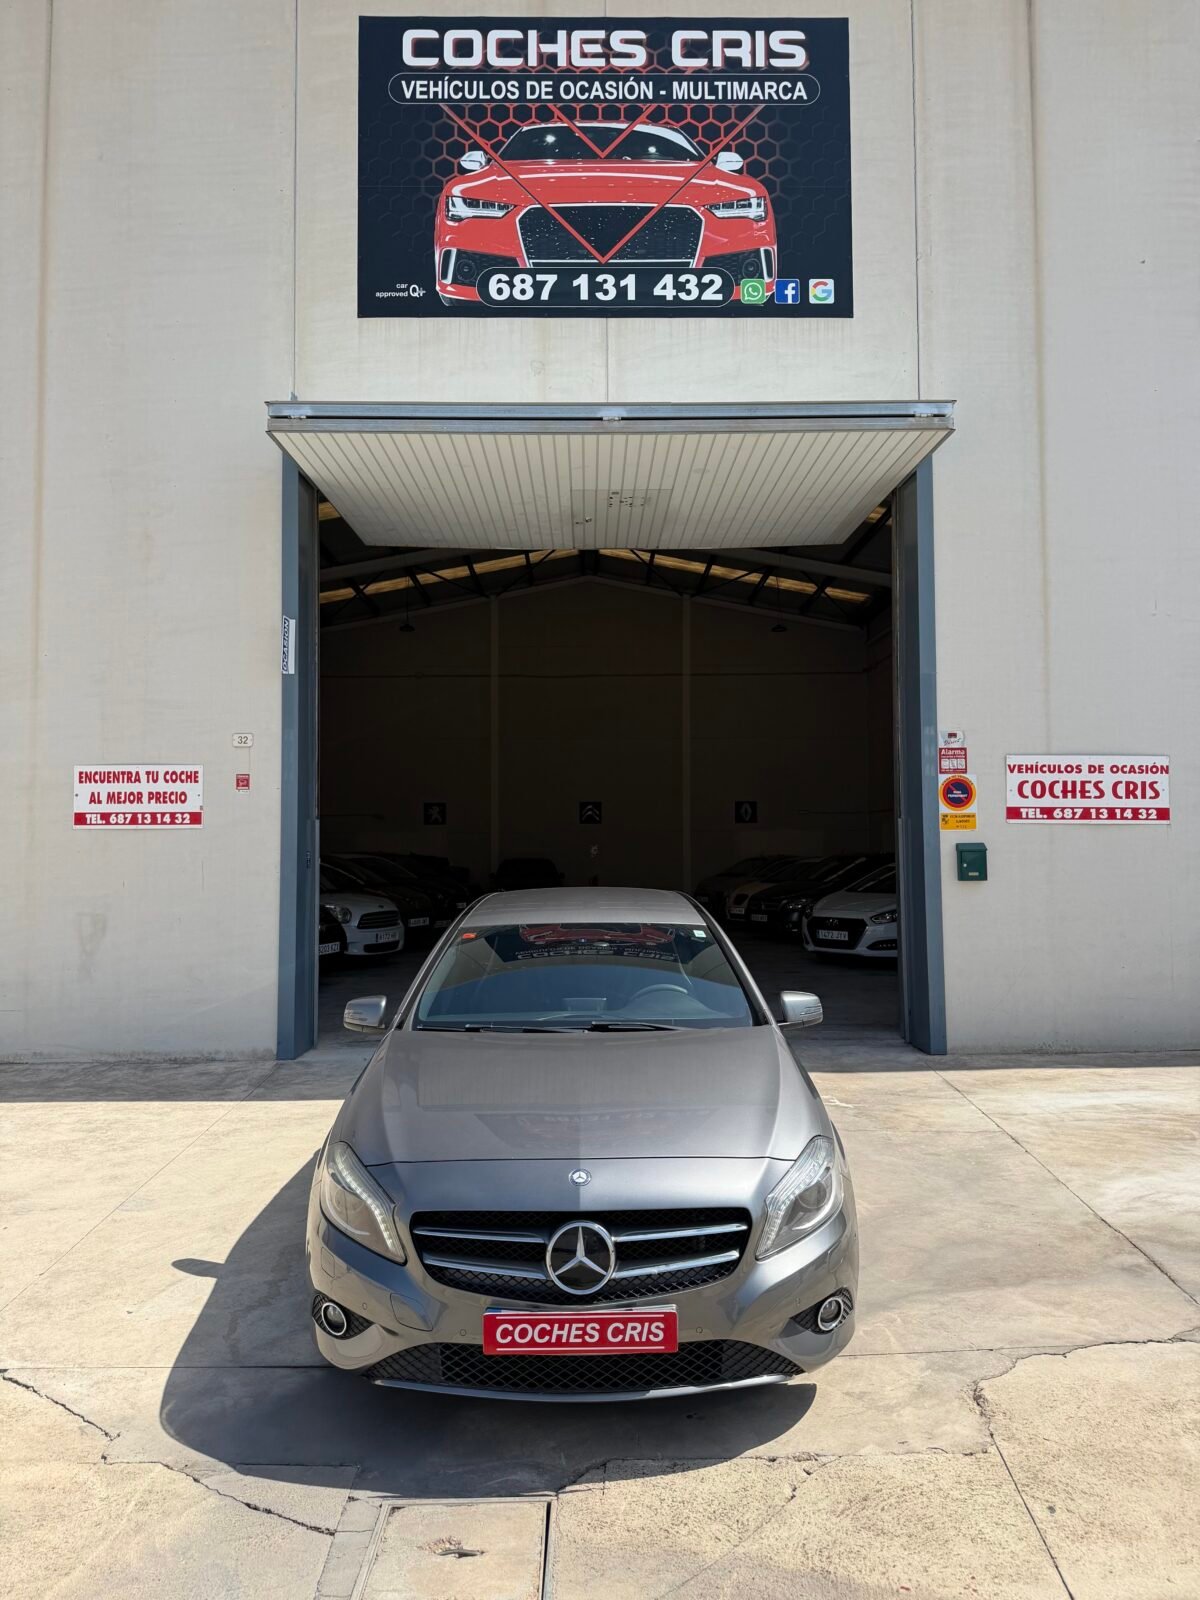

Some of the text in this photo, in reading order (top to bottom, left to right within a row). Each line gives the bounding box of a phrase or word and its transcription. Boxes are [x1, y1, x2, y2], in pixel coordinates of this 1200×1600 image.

[402, 29, 806, 68] COCHES CRIS
[402, 76, 520, 100] VEHÍCULOS
[526, 80, 554, 100] DE
[560, 76, 653, 100] OCASIÓN
[673, 81, 808, 100] MULTIMARCA
[488, 273, 723, 301] 687 131 432
[237, 735, 249, 745] 32
[1007, 761, 1169, 775] VEHÍCULOS DE OCASIÓN
[78, 770, 199, 784] ENCUENTRA TU COCHE
[1017, 779, 1161, 800] COCHES CRIS
[88, 791, 187, 804] AL MEJOR PRECIO
[85, 813, 191, 825] TEL. 687 13 14 32
[1020, 808, 1158, 819] TEL. 687 13 14 32
[495, 1322, 665, 1344] COCHES CRIS
